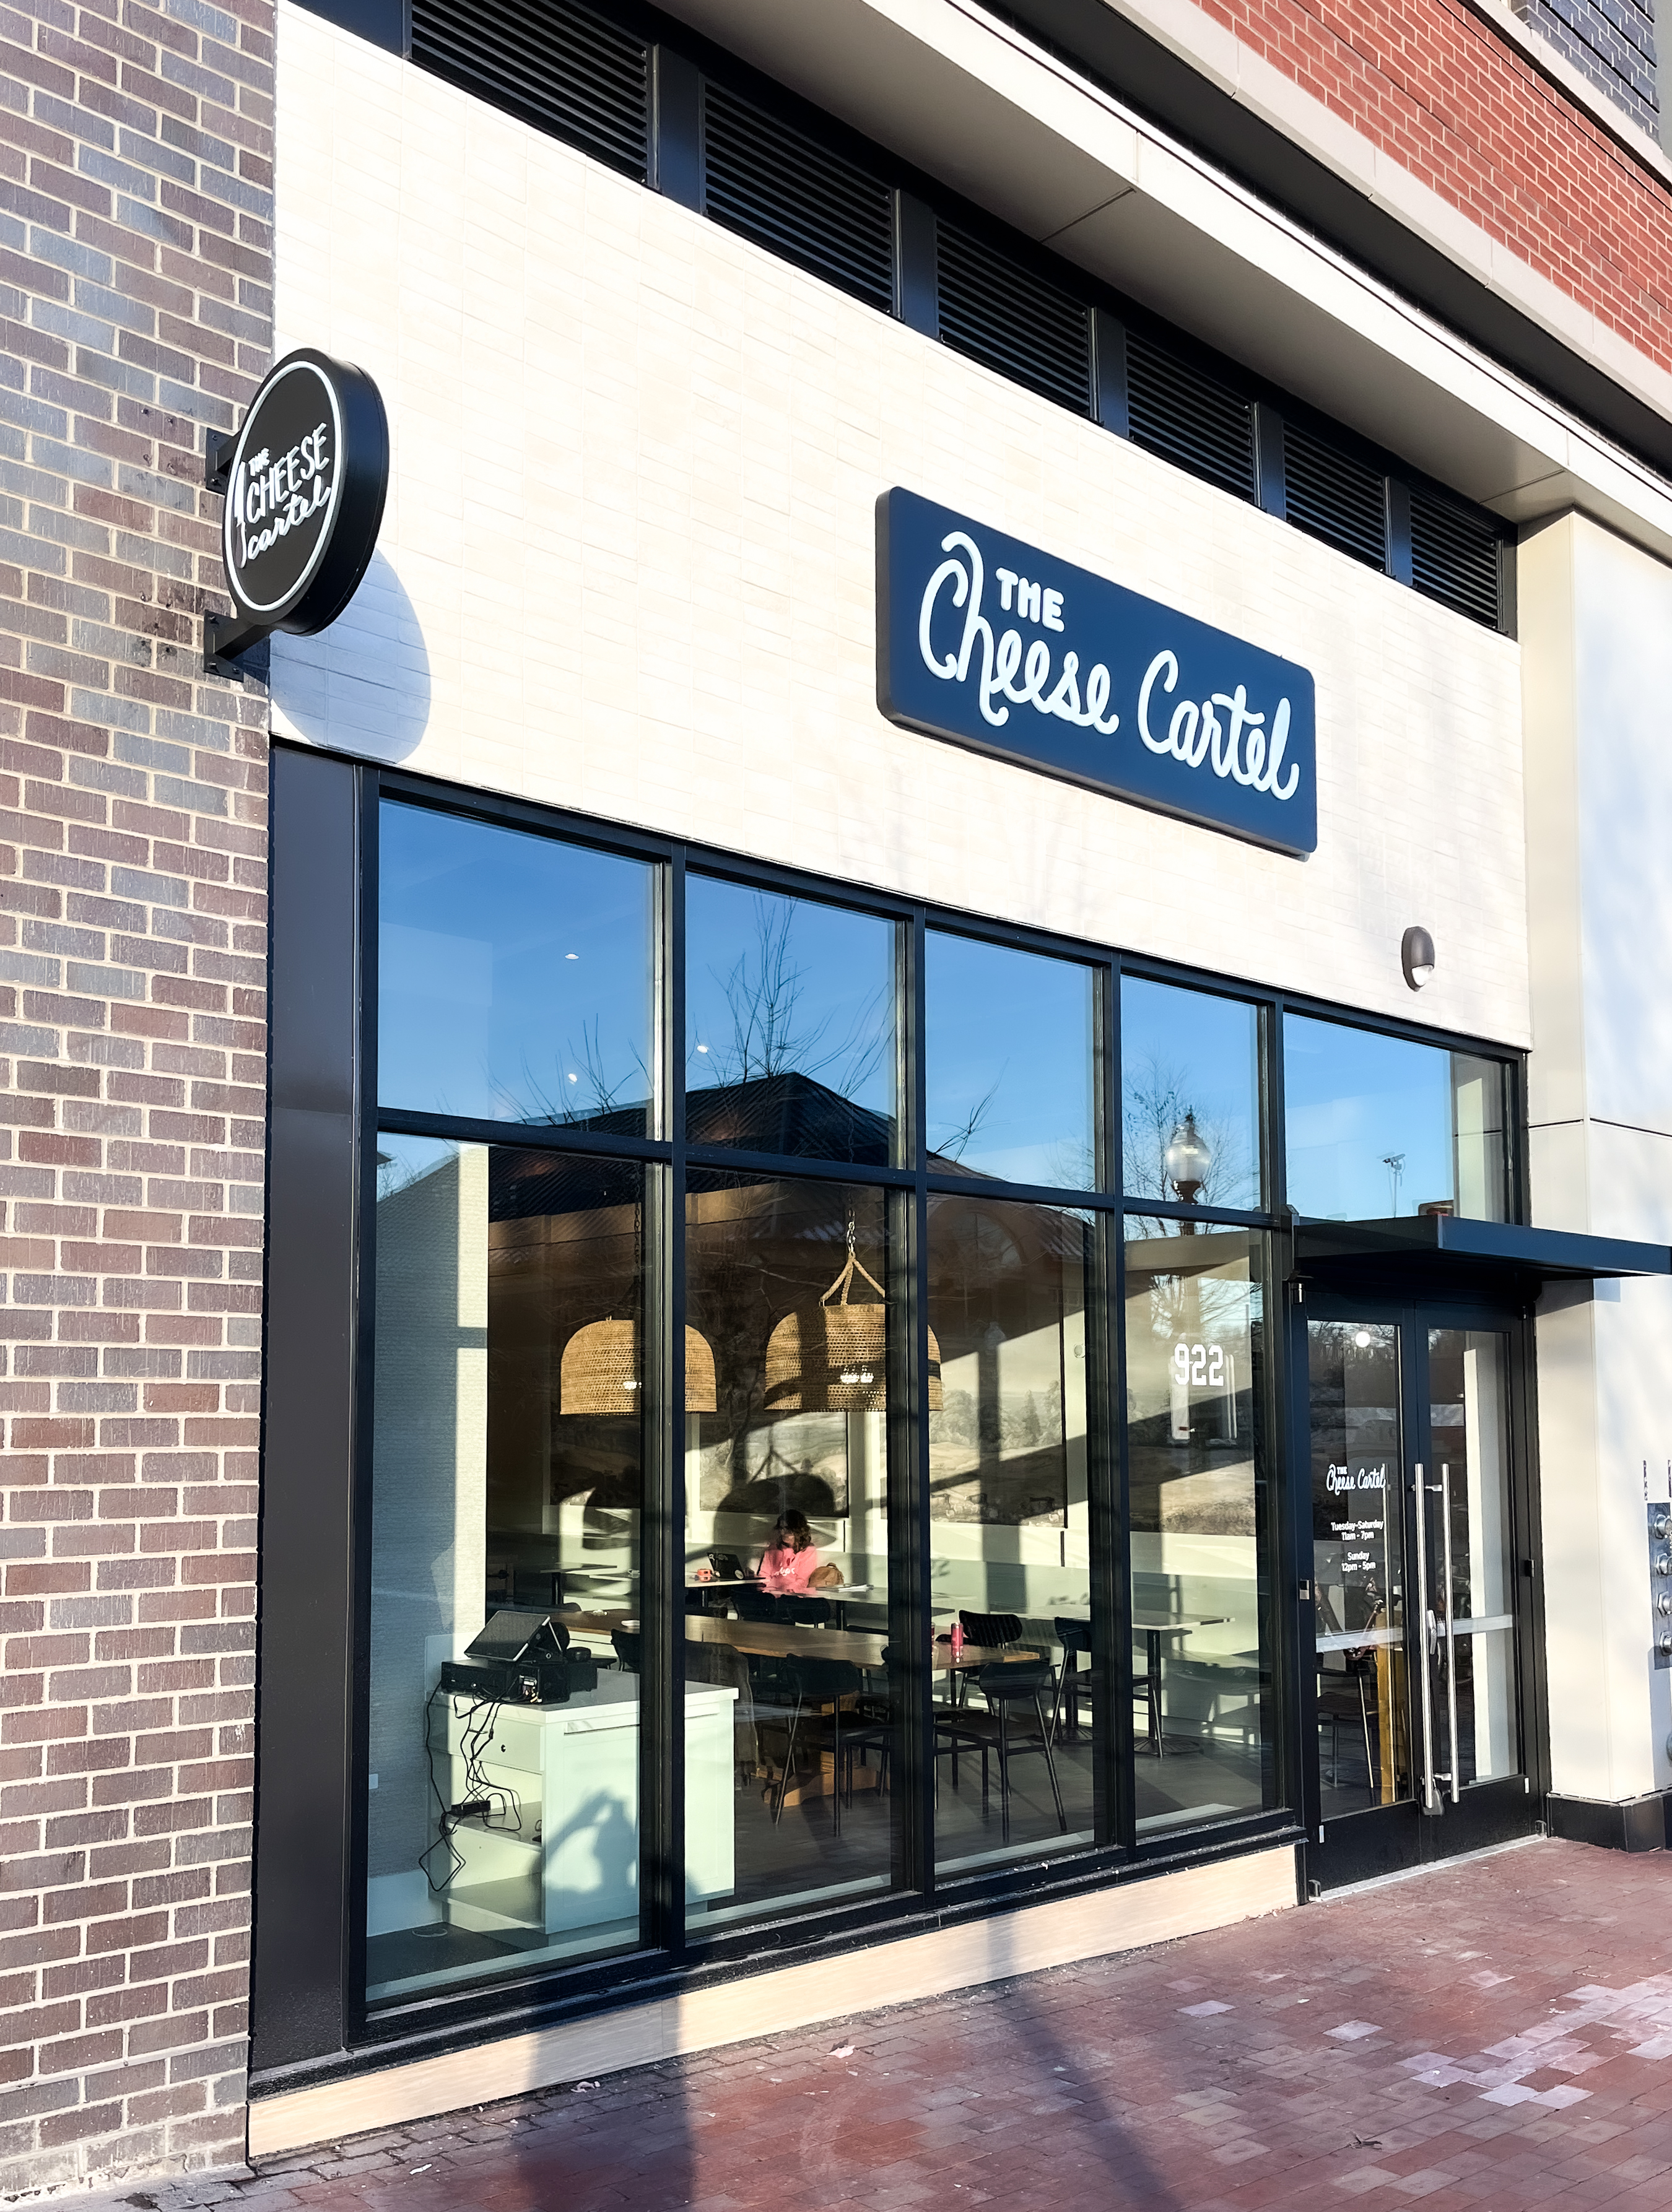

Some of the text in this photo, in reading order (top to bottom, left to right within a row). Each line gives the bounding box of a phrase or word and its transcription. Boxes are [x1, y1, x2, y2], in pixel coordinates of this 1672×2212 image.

[246, 422, 329, 524] CHEESE
[248, 447, 270, 477] THE
[248, 474, 332, 560] cartel
[996, 567, 1065, 632] THE
[918, 531, 1300, 800] Cheese Cartel
[1175, 1343, 1224, 1386] 922
[1326, 1464, 1386, 1495] Cheese Cartel
[1336, 1466, 1347, 1474] THE
[1330, 1519, 1384, 1532] Tuesday-Saturday
[1341, 1532, 1356, 1541] 11am
[1361, 1530, 1375, 1541] 7pm
[1341, 1562, 1358, 1572] 12pm
[1362, 1561, 1376, 1571] 5pm
[1347, 1551, 1370, 1561] Sunday
